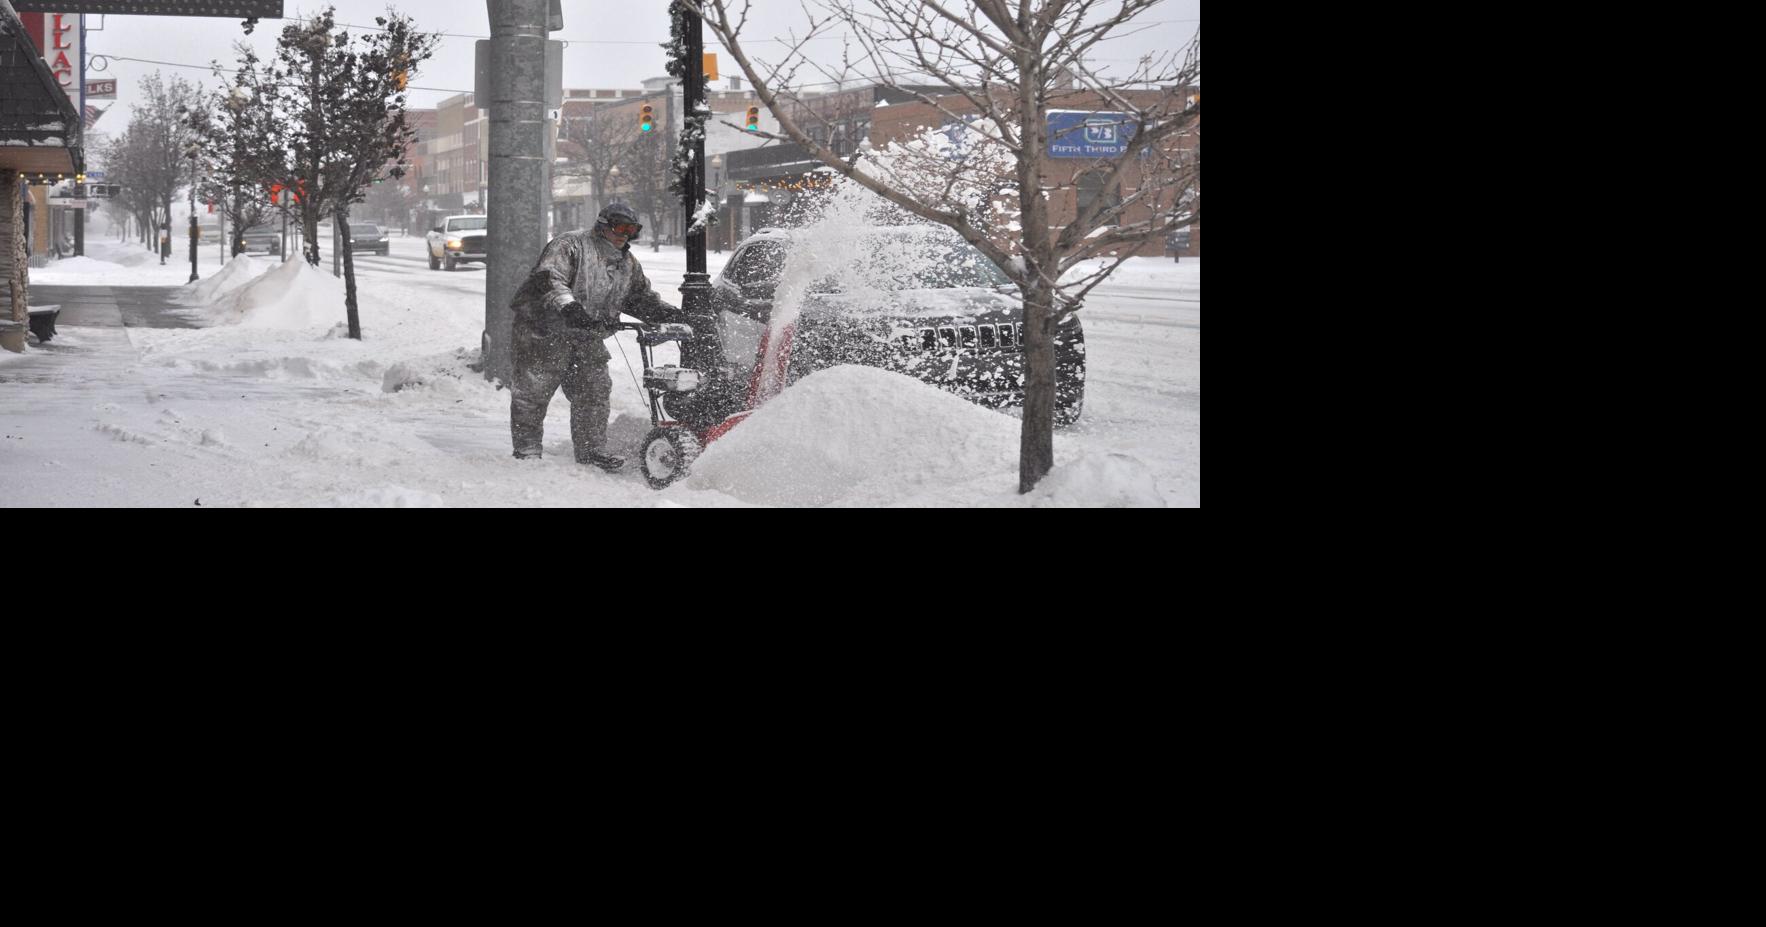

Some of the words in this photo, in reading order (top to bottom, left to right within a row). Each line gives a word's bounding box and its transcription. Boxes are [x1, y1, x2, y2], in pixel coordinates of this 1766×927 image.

[53, 14, 72, 101] LLAC
[1052, 144, 1081, 153] FIFTH
[1084, 144, 1117, 153] THIRD
